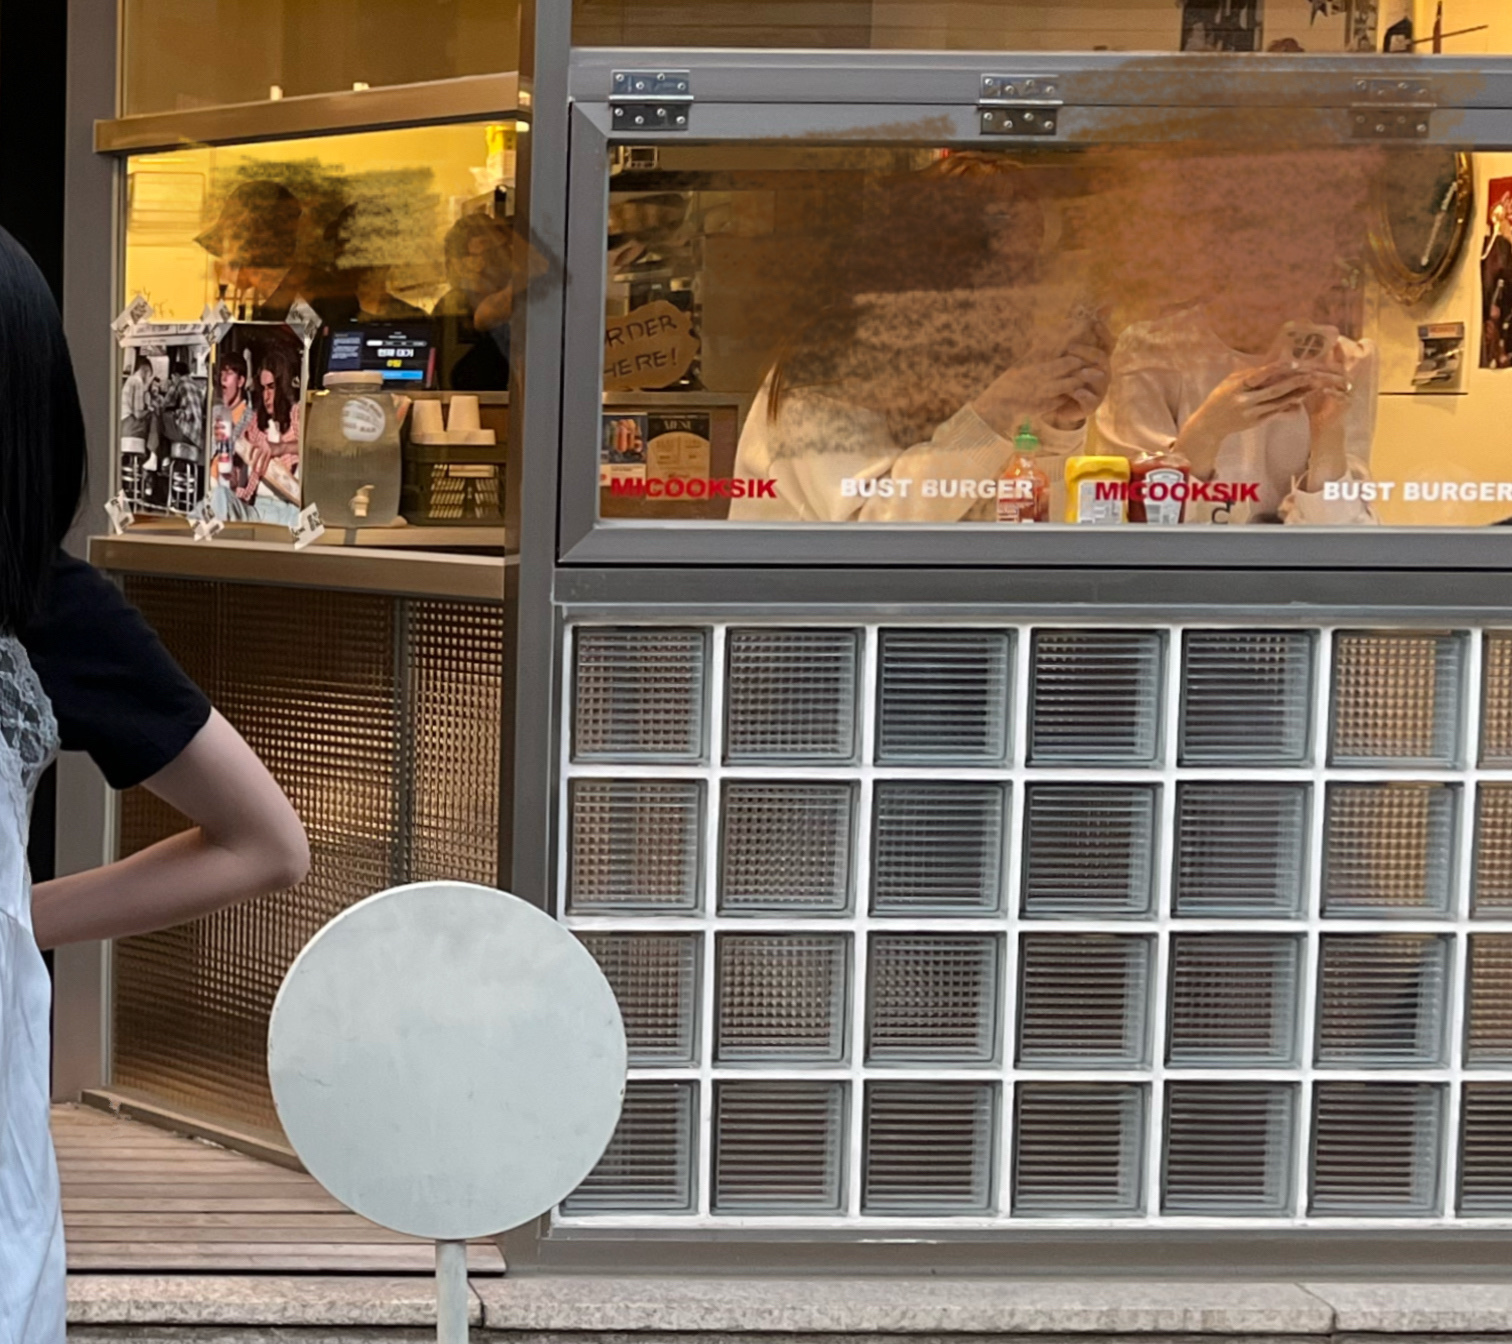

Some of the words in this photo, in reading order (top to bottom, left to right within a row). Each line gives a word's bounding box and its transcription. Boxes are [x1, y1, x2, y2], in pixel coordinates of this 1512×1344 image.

[604, 314, 678, 348] RDER
[610, 477, 778, 499] MICOOKSIK
[840, 478, 913, 498] BUST
[921, 479, 1034, 499] BURGER
[1094, 482, 1261, 502] MICOOKSIK
[1323, 481, 1395, 501] BUST
[1402, 481, 1512, 502] BURGER
